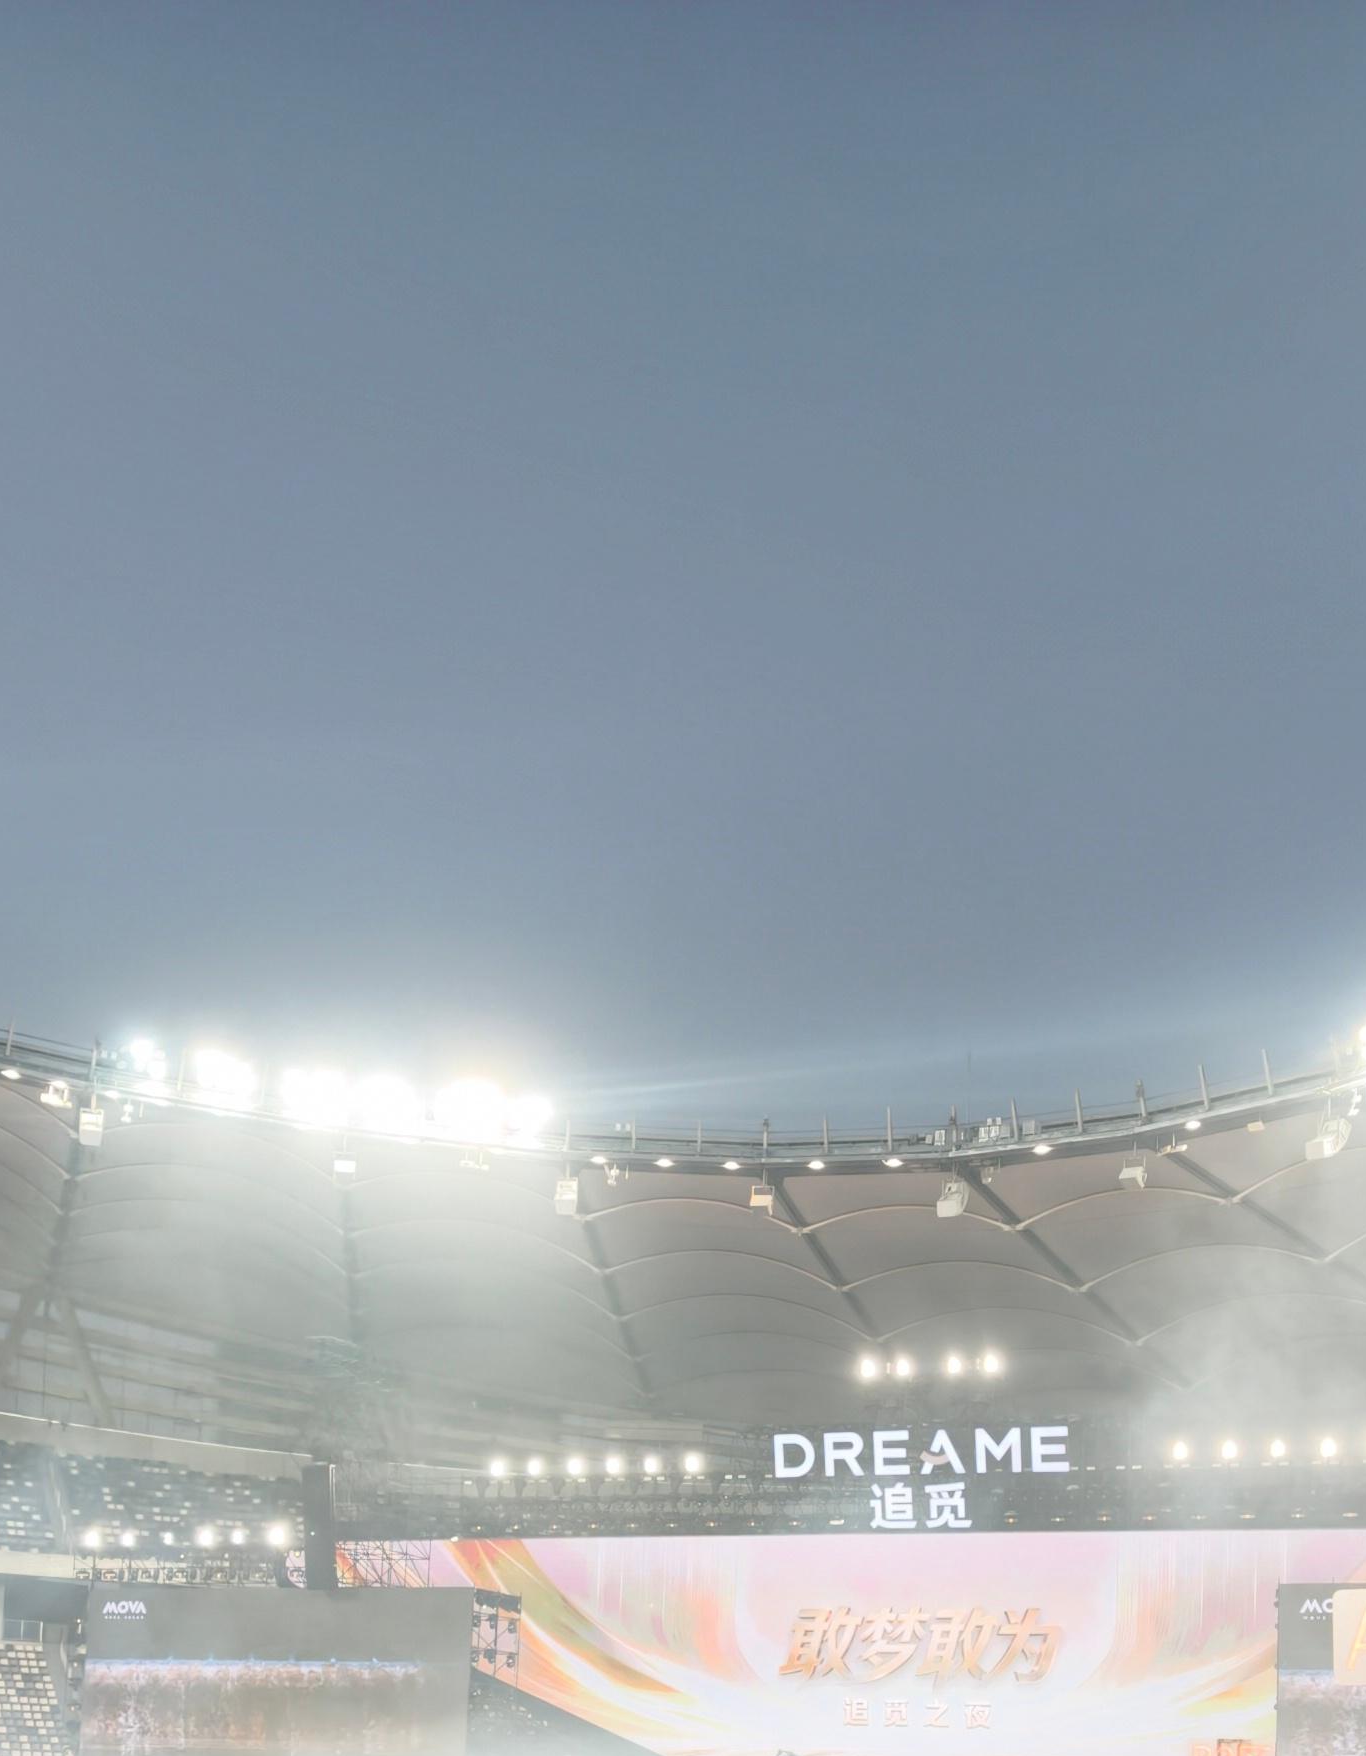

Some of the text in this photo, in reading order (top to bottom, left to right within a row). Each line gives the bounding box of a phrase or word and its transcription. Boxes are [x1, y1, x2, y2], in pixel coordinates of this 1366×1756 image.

[773, 1426, 1070, 1478] DREAME
[870, 1482, 972, 1528] 追觅
[102, 1600, 147, 1615] MOVA
[1299, 1598, 1333, 1614] MO
[779, 1606, 1064, 1685] 敢梦敢为
[842, 1697, 993, 1729] 追觅之夜
